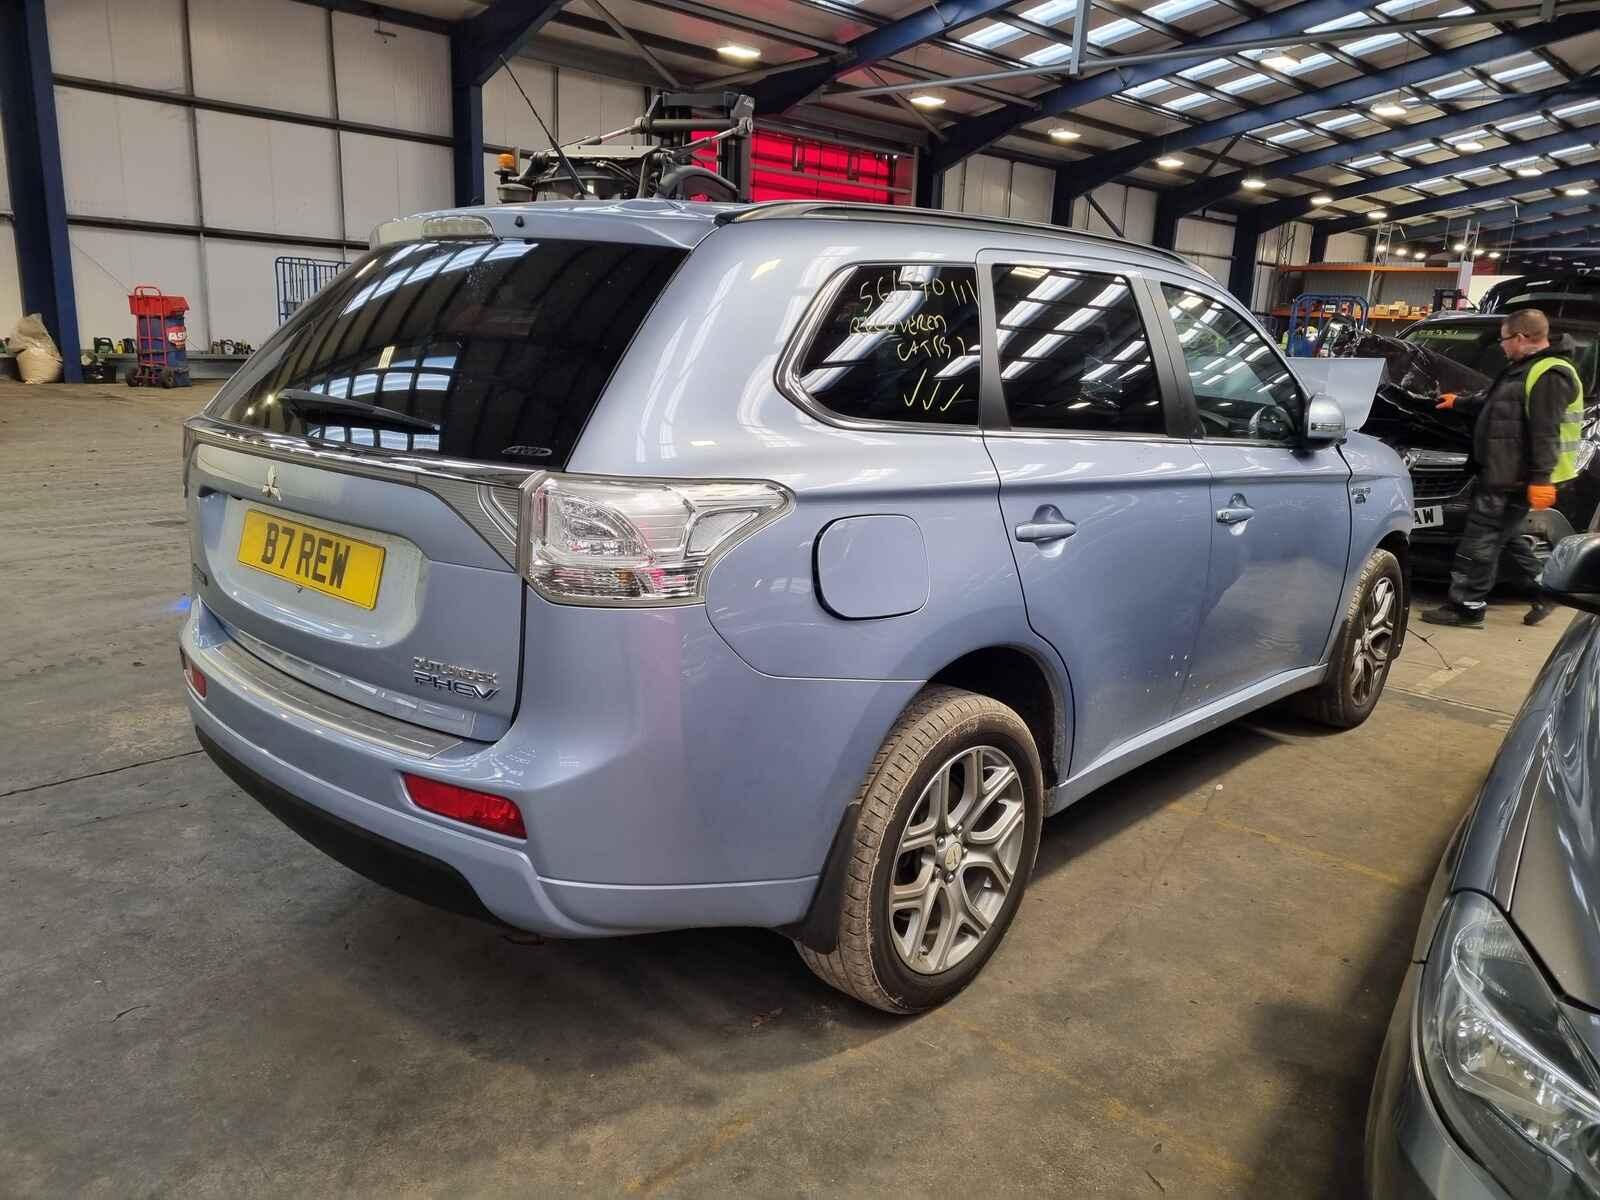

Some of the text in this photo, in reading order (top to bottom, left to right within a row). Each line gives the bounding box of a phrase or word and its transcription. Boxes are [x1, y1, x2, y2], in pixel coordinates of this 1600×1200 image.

[261, 522, 351, 589] B7 REW
[413, 656, 497, 684] OUTLANDER
[413, 669, 501, 700] PHEV
